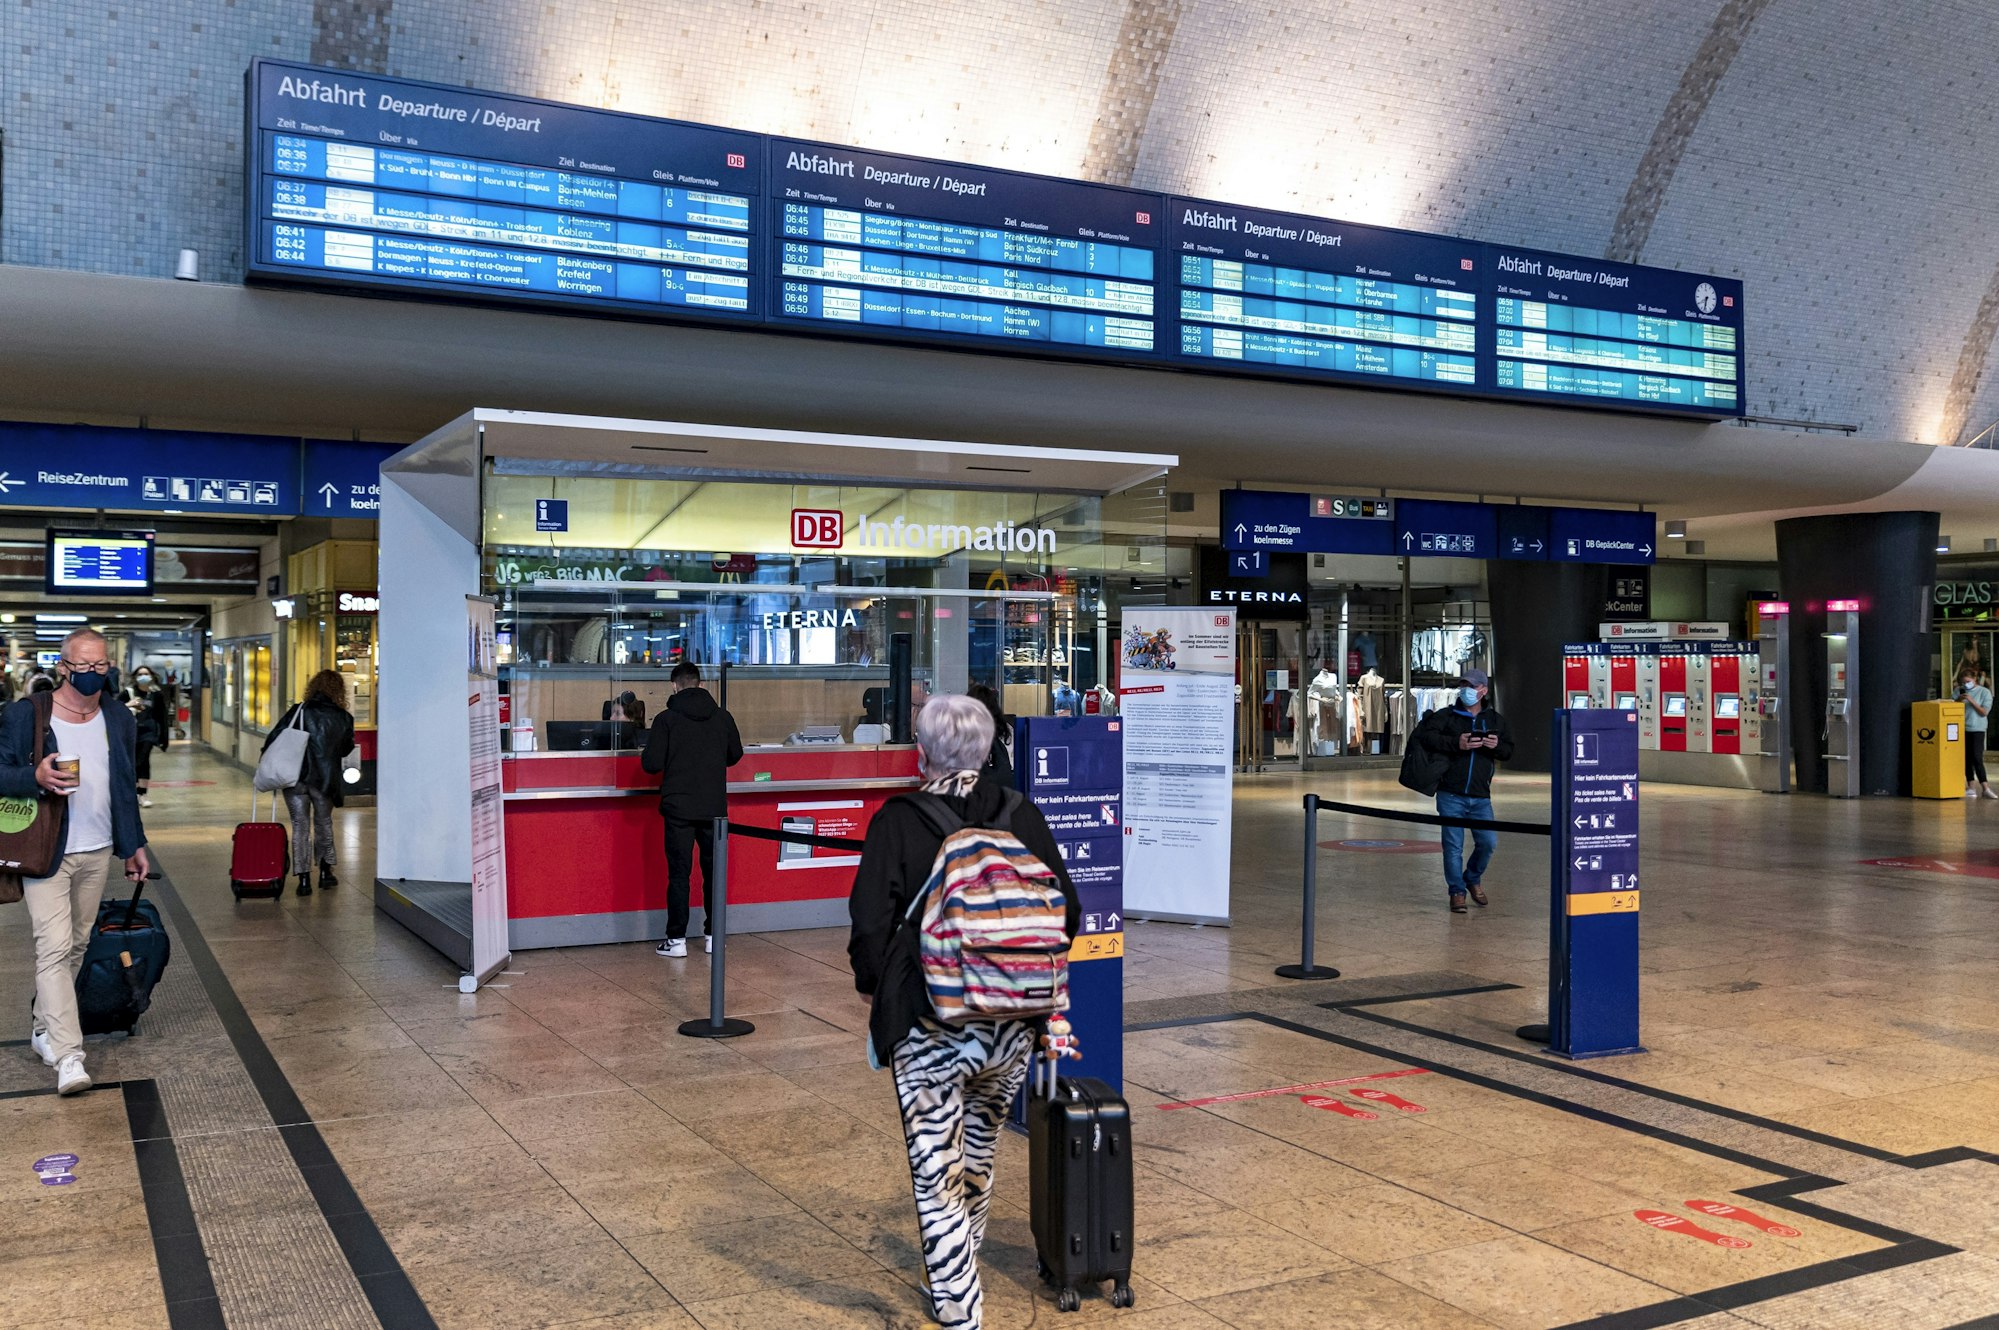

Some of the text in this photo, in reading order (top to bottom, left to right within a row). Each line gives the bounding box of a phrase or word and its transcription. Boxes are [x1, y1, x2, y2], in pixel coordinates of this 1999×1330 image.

[278, 76, 541, 132] Abfahrt Departure Départ
[277, 117, 296, 130] Zeit
[379, 130, 402, 143] Über
[277, 148, 307, 160] 06:36
[558, 156, 616, 173] Ziel Destination
[652, 170, 674, 181] Gleis
[786, 152, 986, 196] Abfahrt Departure Départ
[558, 185, 617, 200] Bonn-Mehlem
[786, 188, 800, 198] Zeit
[277, 193, 306, 205] 06:38
[865, 197, 882, 209] Über
[386, 207, 542, 233] Messe/Deutz Troisdorf
[865, 216, 954, 233] Siegburg/Bonn Montabaur
[1004, 218, 1049, 231] Ziel Destination
[275, 225, 305, 237] 06:41
[557, 226, 593, 239] Koblenz
[1078, 227, 1095, 237] Gleis
[1183, 208, 1342, 247] Abfahrt Departure Départ
[865, 236, 891, 246] Aachen
[906, 231, 939, 241] Dortmund
[275, 237, 305, 249] 06:42
[1004, 242, 1024, 252] Berlin
[1056, 239, 1078, 249] Fernbf
[1183, 242, 1194, 250] Zeit
[275, 249, 305, 261] 06:44
[386, 239, 542, 264] Messe/Deutz Troisdorf
[1004, 252, 1041, 263] Paris Nord
[1245, 248, 1259, 259] Über
[378, 251, 523, 273] Dormagen Neuss Krefeld-Oppum
[557, 257, 612, 273] Blankenberg
[386, 264, 530, 285] Nippes Longerich Chorweiler
[557, 268, 591, 280] Krefeld
[871, 265, 915, 276] Messe/Deutz
[1498, 255, 1629, 288] Abfahrt Departure Départ
[557, 279, 602, 293] Worringen
[785, 283, 808, 293] 06:48
[1004, 279, 1068, 294] Bergisch Gladbach
[785, 293, 808, 303] 06:49
[1356, 297, 1383, 306] Karlsruhe
[785, 303, 808, 314] 06:50
[865, 302, 992, 322] Düsseldorf Essen Bochum Dortmund
[1004, 307, 1030, 316] Aachen
[1004, 326, 1029, 336] Horrem
[38, 471, 129, 488] ReiseZentrum
[351, 484, 380, 495] zu de
[350, 498, 380, 510] koeln
[1333, 500, 1344, 516] S
[796, 512, 840, 544] DB
[859, 514, 1056, 553] Information
[1264, 525, 1278, 533] den
[1279, 525, 1301, 536] Zügen
[1254, 535, 1293, 545] koelnmesse
[1422, 541, 1432, 549] WC
[1586, 540, 1635, 550] DB GepäckCenter
[1252, 551, 1261, 569] 1
[1210, 590, 1302, 602] ETERNA
[1934, 581, 1992, 605] GLAS
[763, 608, 857, 630] ETERNA
[1216, 617, 1228, 626] DB
[1611, 625, 1622, 635] DB
[1689, 626, 1719, 634] Information
[1108, 722, 1119, 731] DB
[1034, 793, 1119, 804] Hier kein Fahrkartenverkauf
[1083, 820, 1099, 828] billets
